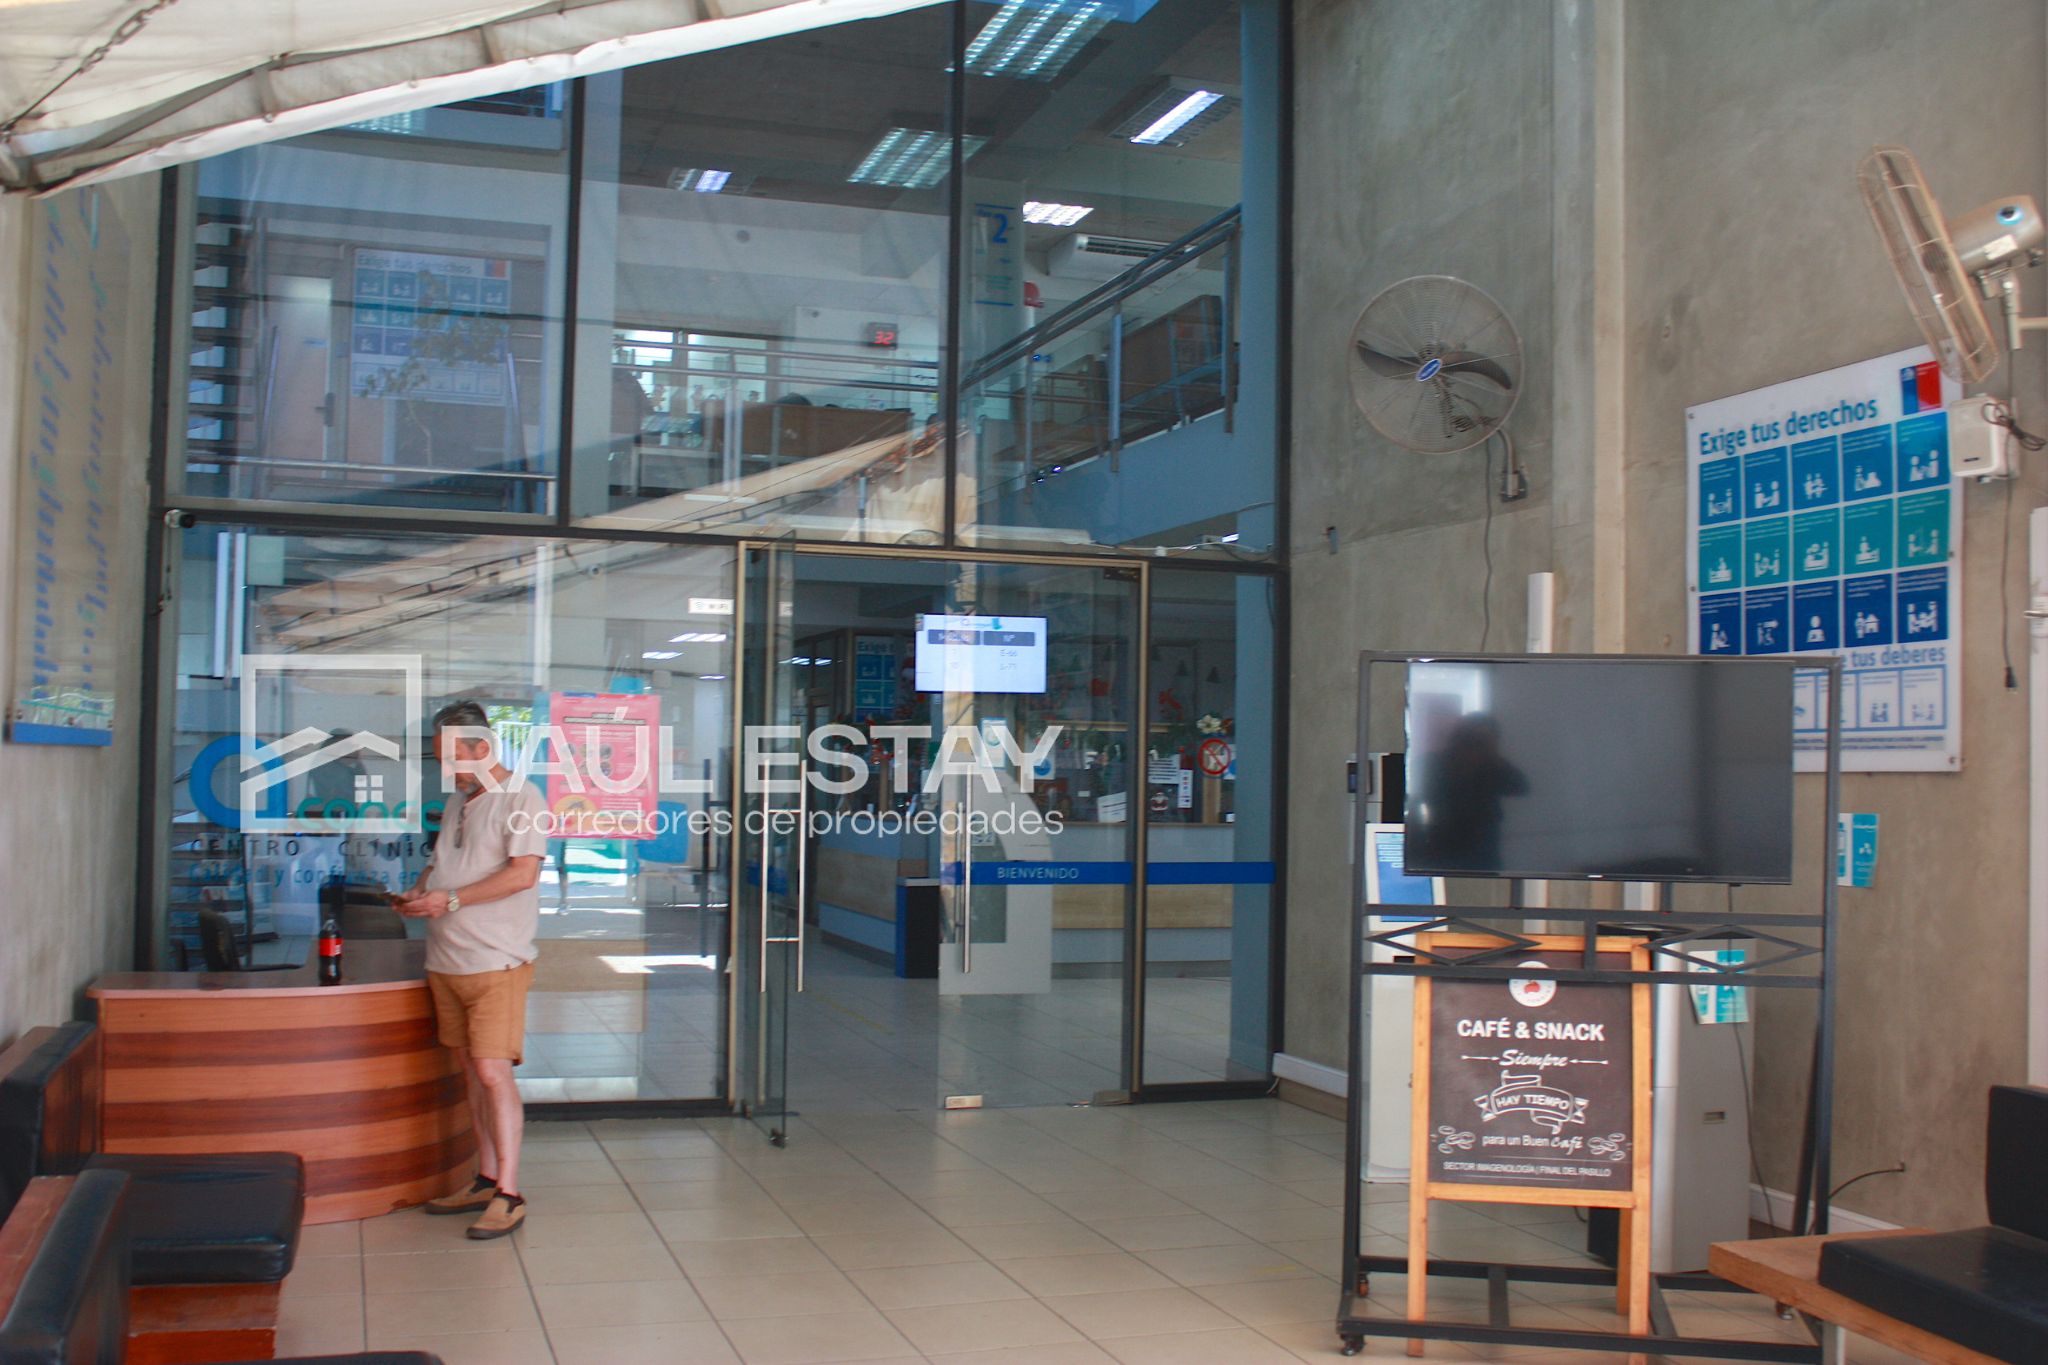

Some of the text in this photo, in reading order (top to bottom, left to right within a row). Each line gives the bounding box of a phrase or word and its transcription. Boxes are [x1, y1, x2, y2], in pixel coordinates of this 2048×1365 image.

[992, 213, 1008, 244] 2
[875, 331, 897, 345] 32
[1699, 427, 1747, 456] Exige
[1751, 420, 1781, 444] tus
[1785, 399, 1878, 436] derechos
[1852, 650, 1876, 667] tus
[1880, 645, 1947, 665] deberes
[190, 838, 300, 857] CENTRO
[274, 869, 285, 888] y
[398, 870, 419, 885] en
[997, 867, 1079, 880] BIENVENIDO
[1457, 1017, 1605, 1041] CAFÉ & SNACK
[1499, 1049, 1569, 1070] Siempre
[1496, 1094, 1571, 1111] HAY TIEMPO
[1482, 1135, 1506, 1147] para
[1507, 1136, 1521, 1147] un
[1523, 1135, 1549, 1148] Buen
[1443, 1161, 1475, 1171] SECTOR
[1539, 1165, 1563, 1175] FINAL
[1563, 1167, 1578, 1176] DEL
